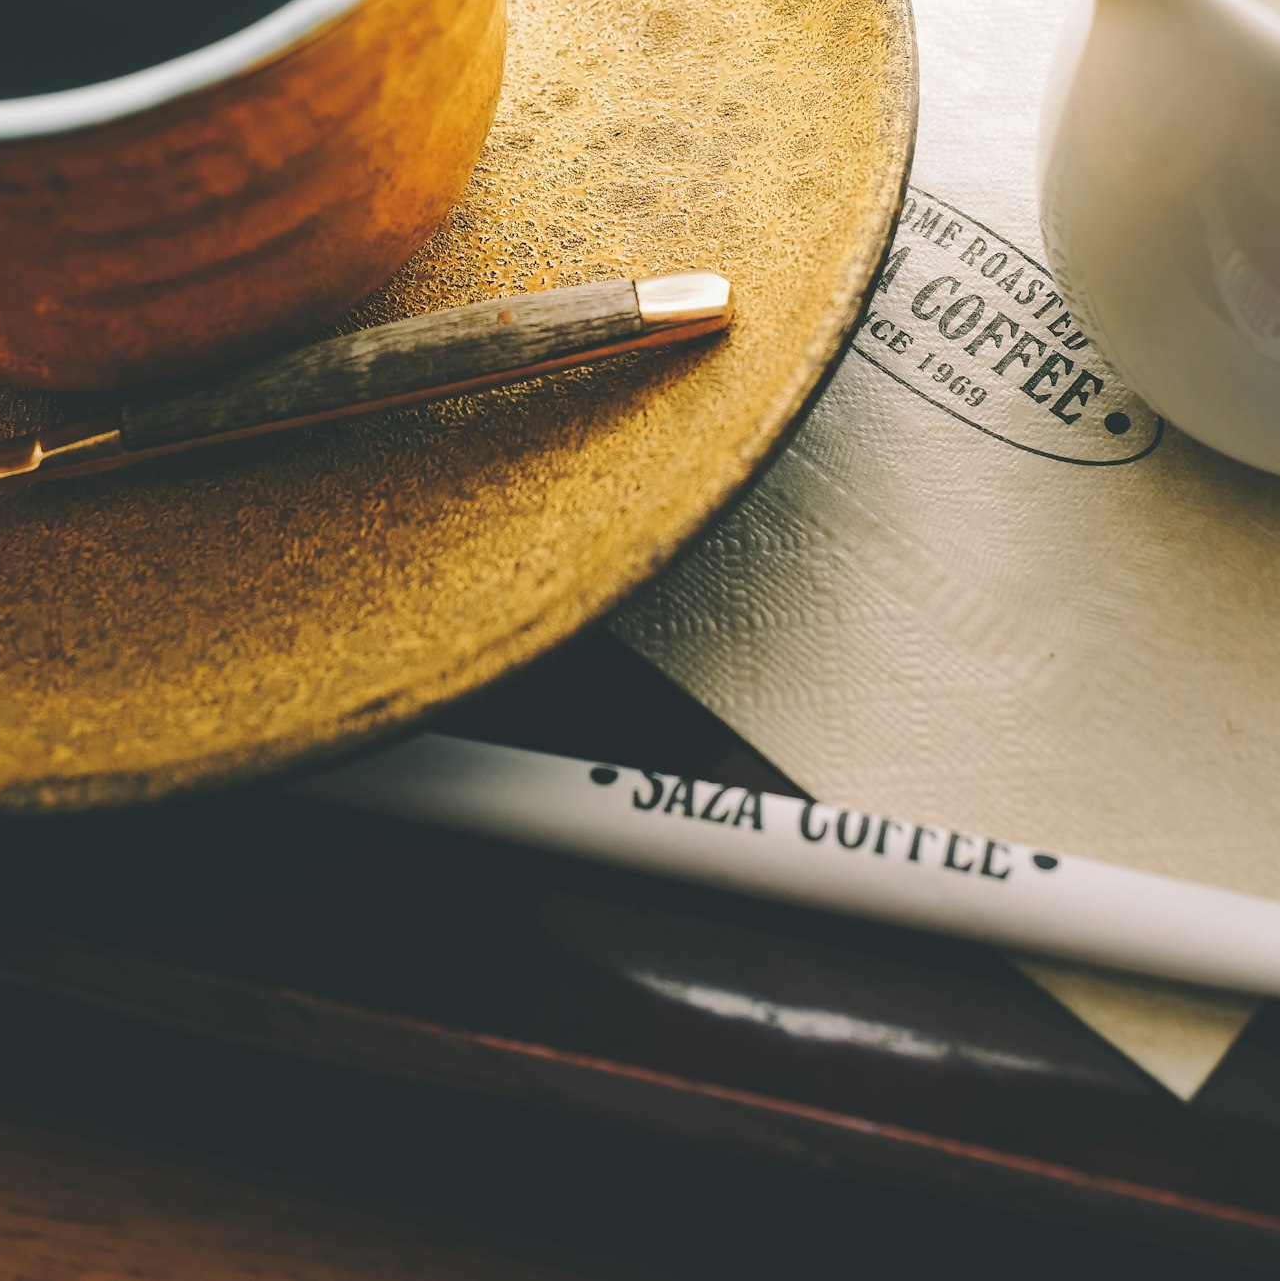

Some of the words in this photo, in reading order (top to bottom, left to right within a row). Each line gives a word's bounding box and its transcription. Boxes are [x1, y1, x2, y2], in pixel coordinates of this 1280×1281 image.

[959, 236, 1089, 351] ROASTED
[911, 275, 1105, 426] COFFEE
[916, 352, 988, 408] 1969
[632, 768, 763, 831] SAZA
[800, 801, 1012, 880] COFFEE
